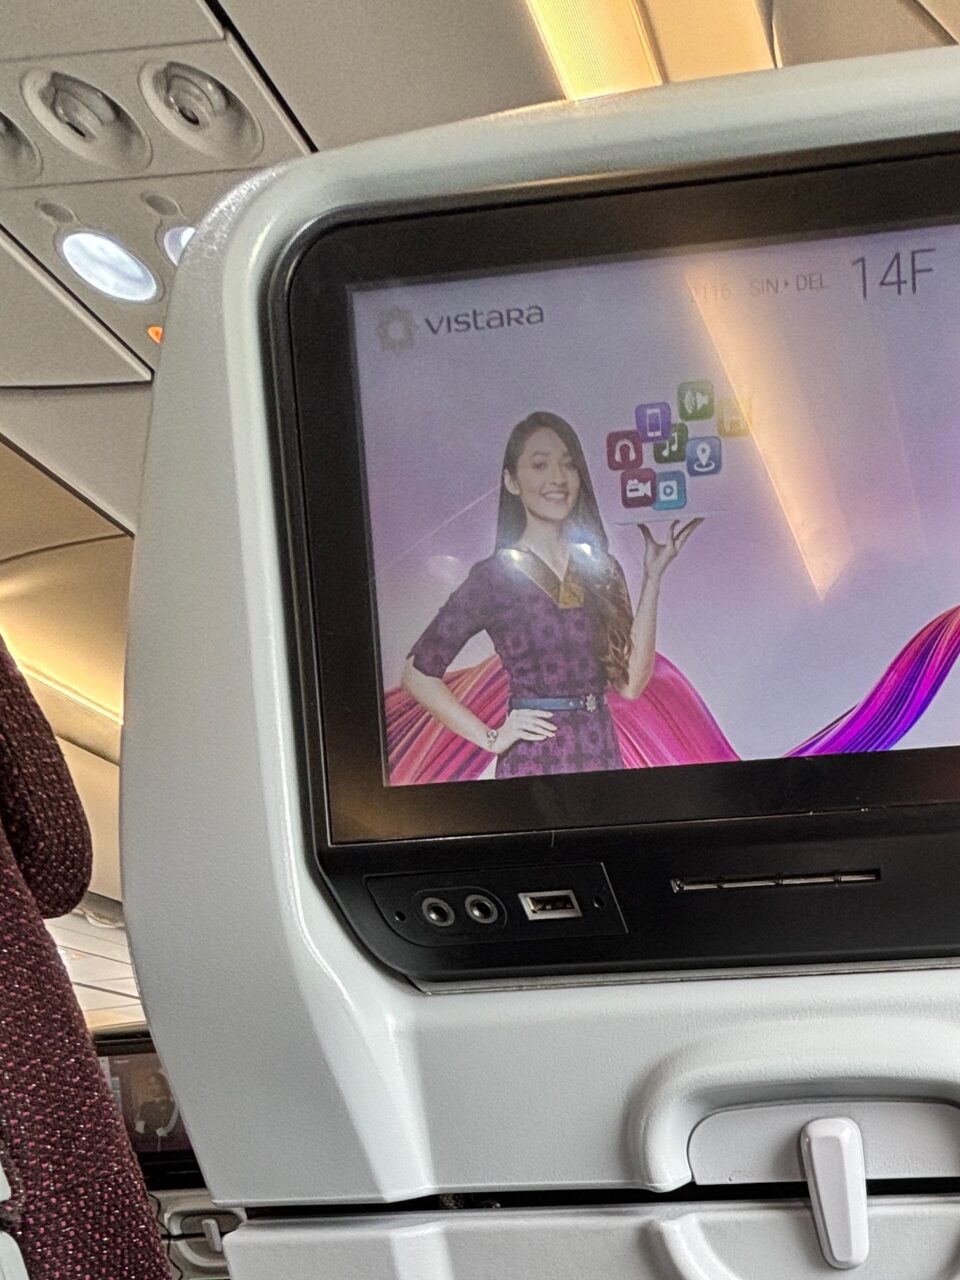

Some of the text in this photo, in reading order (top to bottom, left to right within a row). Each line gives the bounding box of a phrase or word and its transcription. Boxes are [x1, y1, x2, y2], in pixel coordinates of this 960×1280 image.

[750, 278, 779, 298] SIN
[796, 272, 829, 291] DEL
[852, 248, 936, 299] 14F
